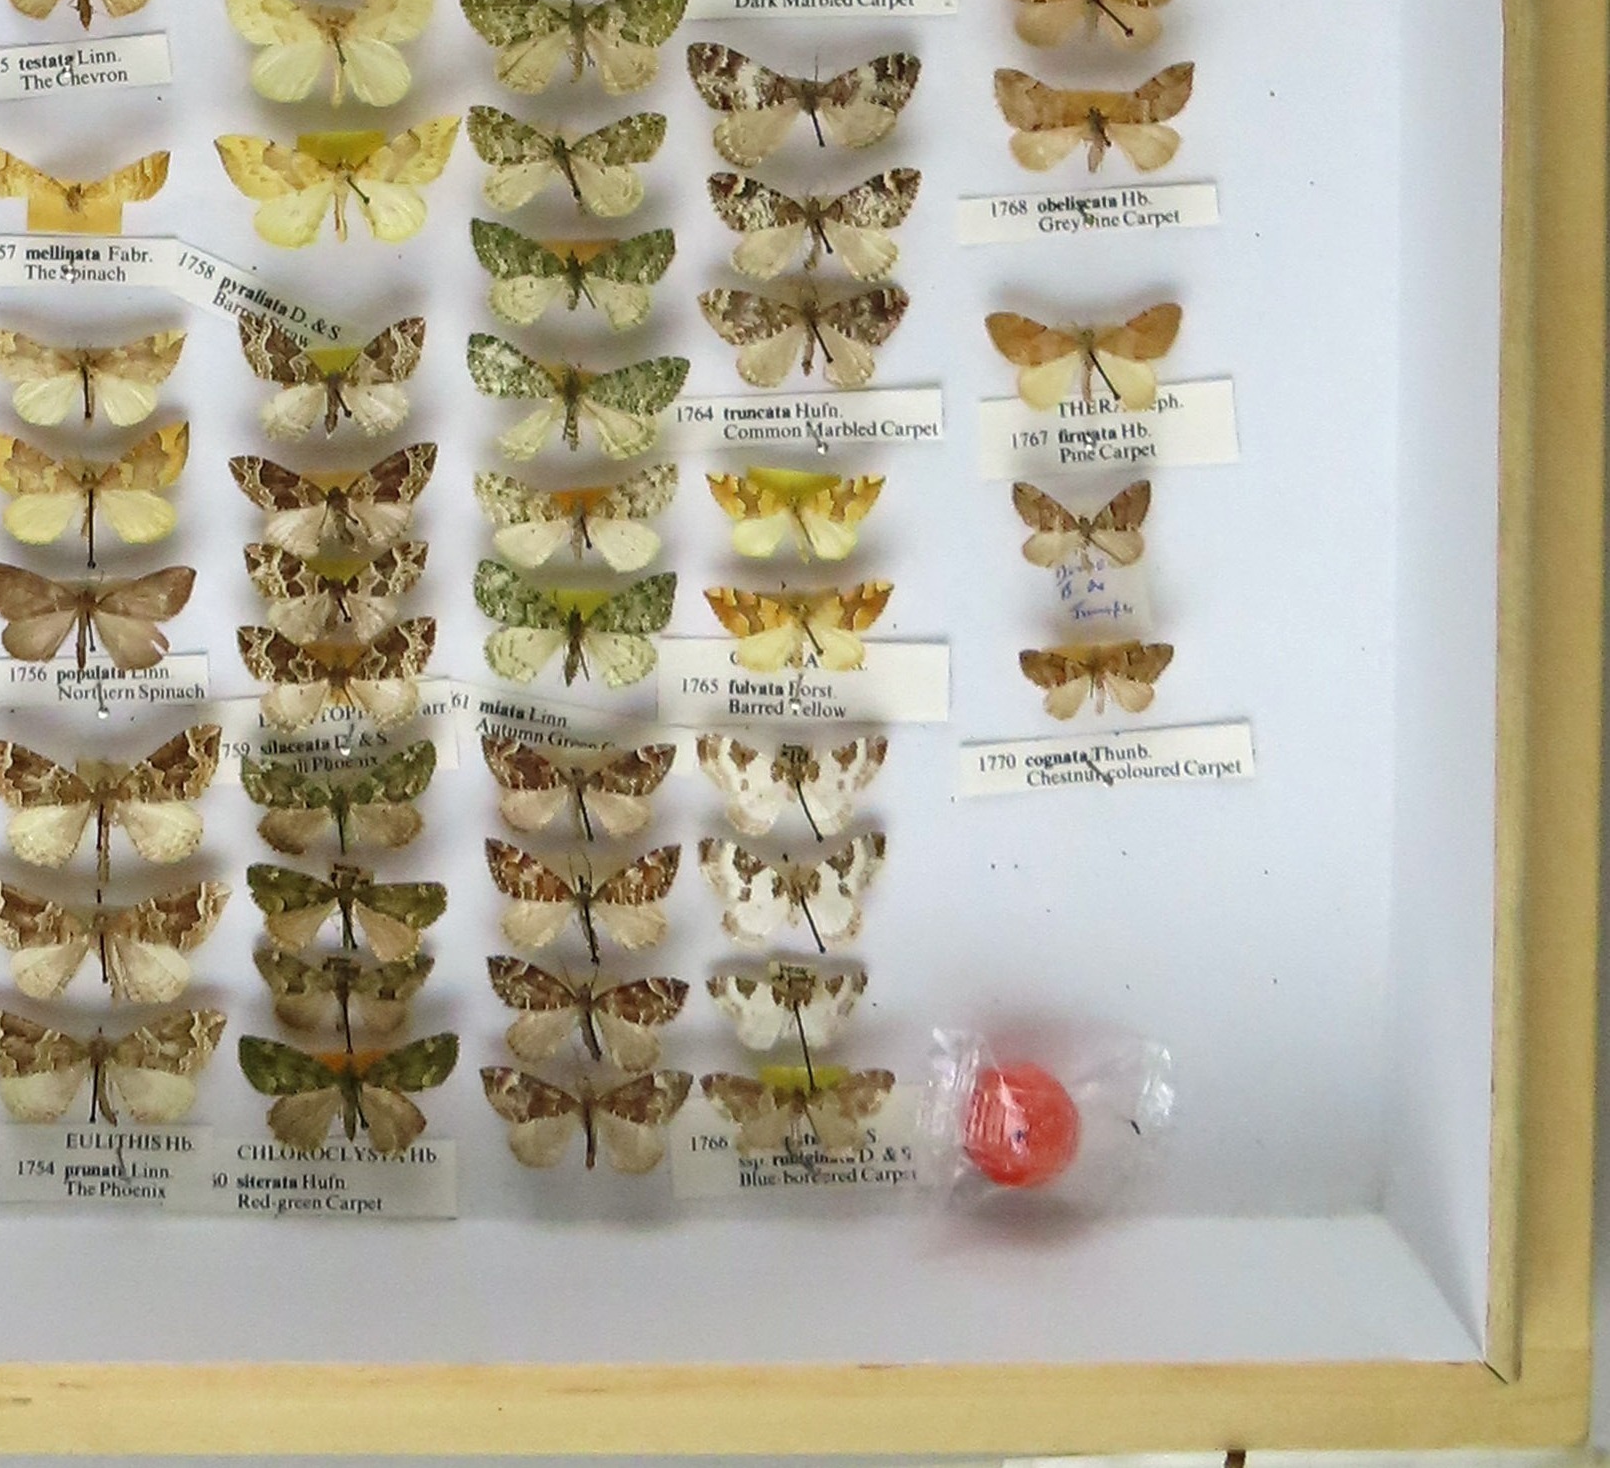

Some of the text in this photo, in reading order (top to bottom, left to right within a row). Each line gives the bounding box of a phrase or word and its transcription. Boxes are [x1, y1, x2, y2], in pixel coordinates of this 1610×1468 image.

[77, 49, 122, 66] Linn.
[20, 75, 53, 91] The
[676, 406, 791, 423] 1764 truncata
[1059, 442, 1157, 464] Pine Carpet
[682, 677, 719, 693] 1765
[979, 755, 1016, 772] 1770
[65, 1180, 166, 1199] The Phoenix
